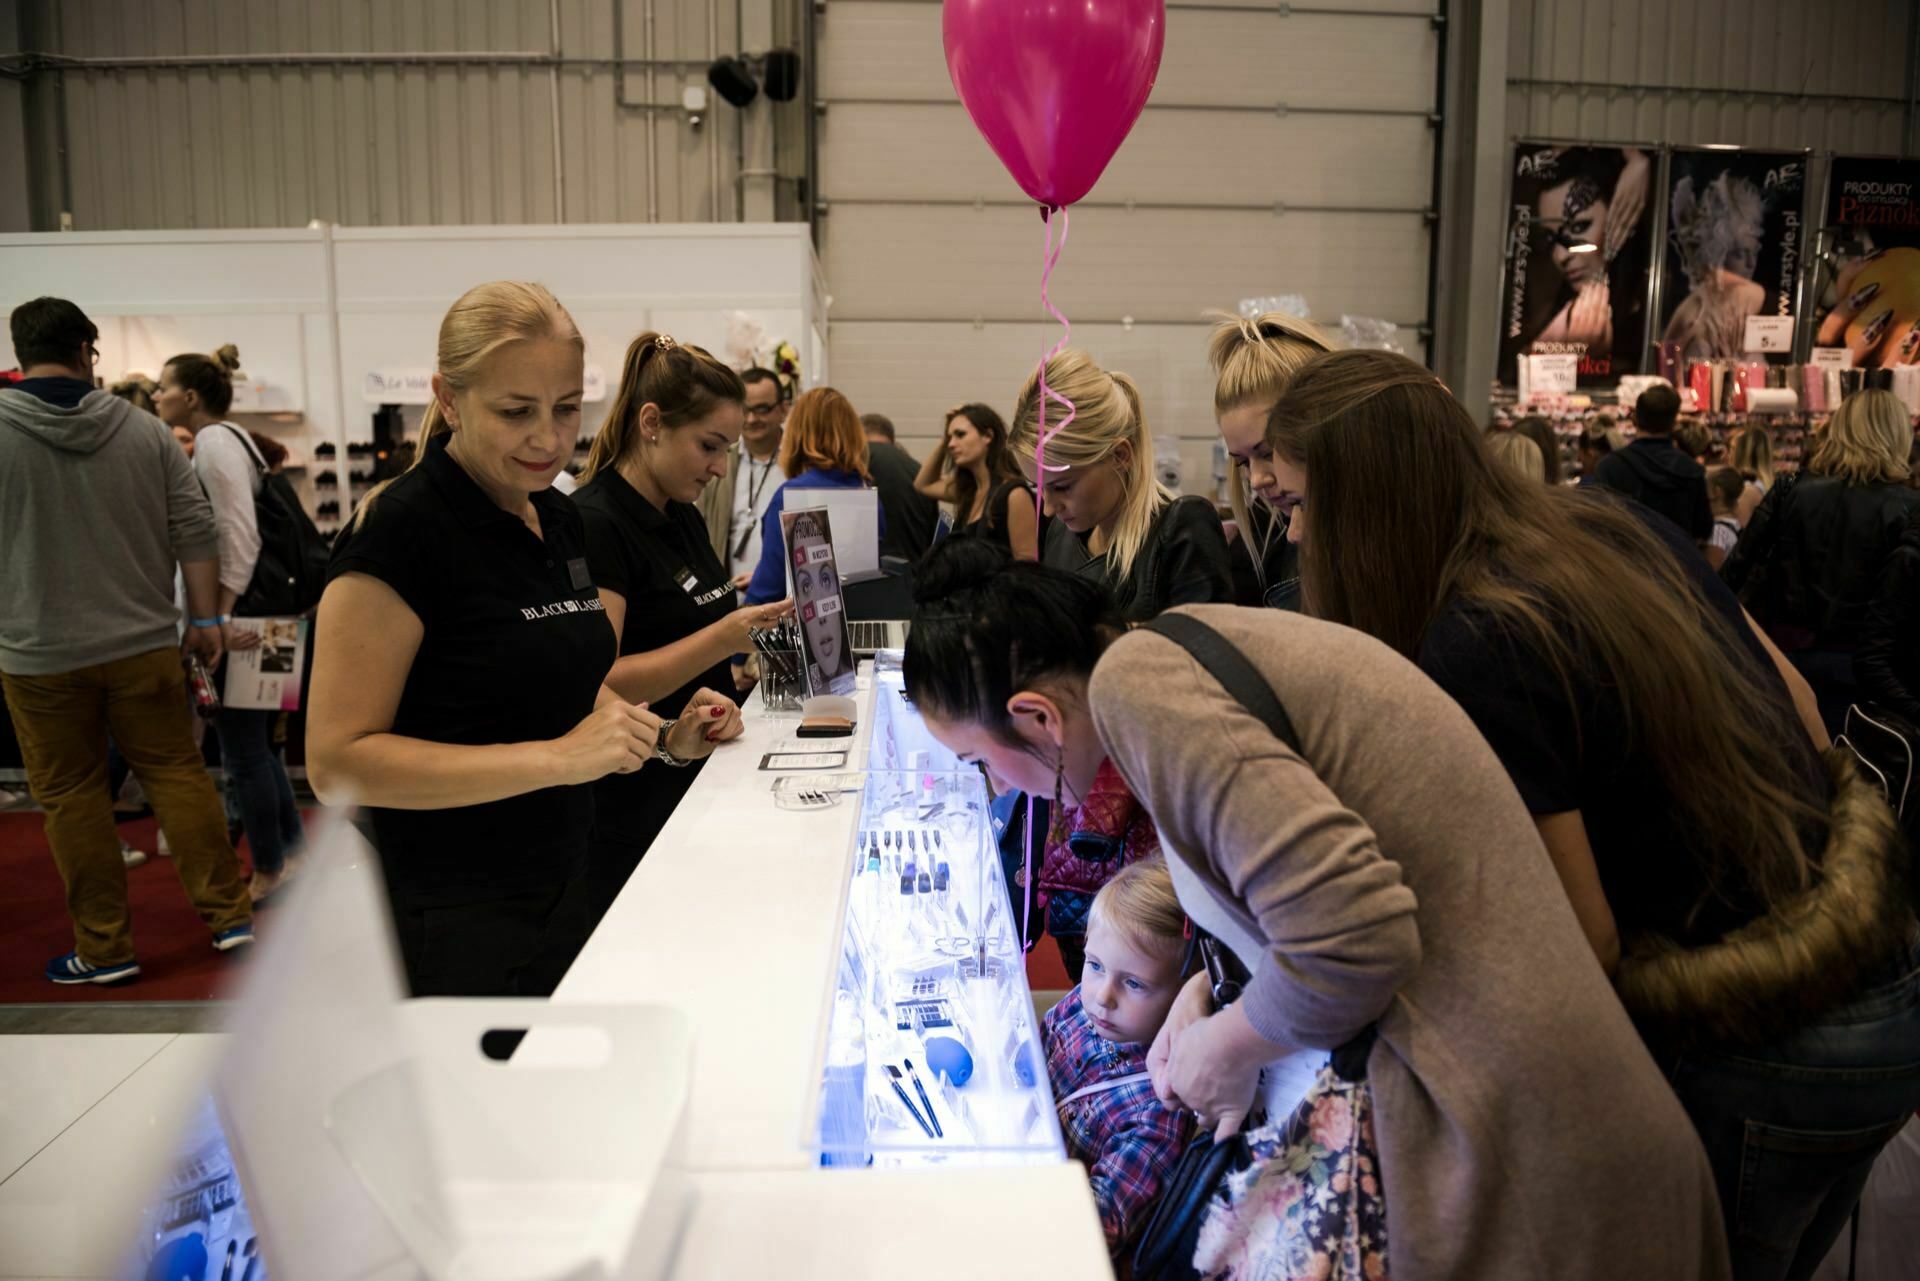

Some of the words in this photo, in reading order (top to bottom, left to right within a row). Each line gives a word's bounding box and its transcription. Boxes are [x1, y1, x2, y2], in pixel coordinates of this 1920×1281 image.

[1843, 181, 1912, 195] PRODUKTY
[1509, 204, 1532, 338] www.arstyle.pl
[1532, 342, 1589, 354] PRODUKTY
[694, 592, 716, 605] BLACK
[521, 602, 568, 620] BLACK
